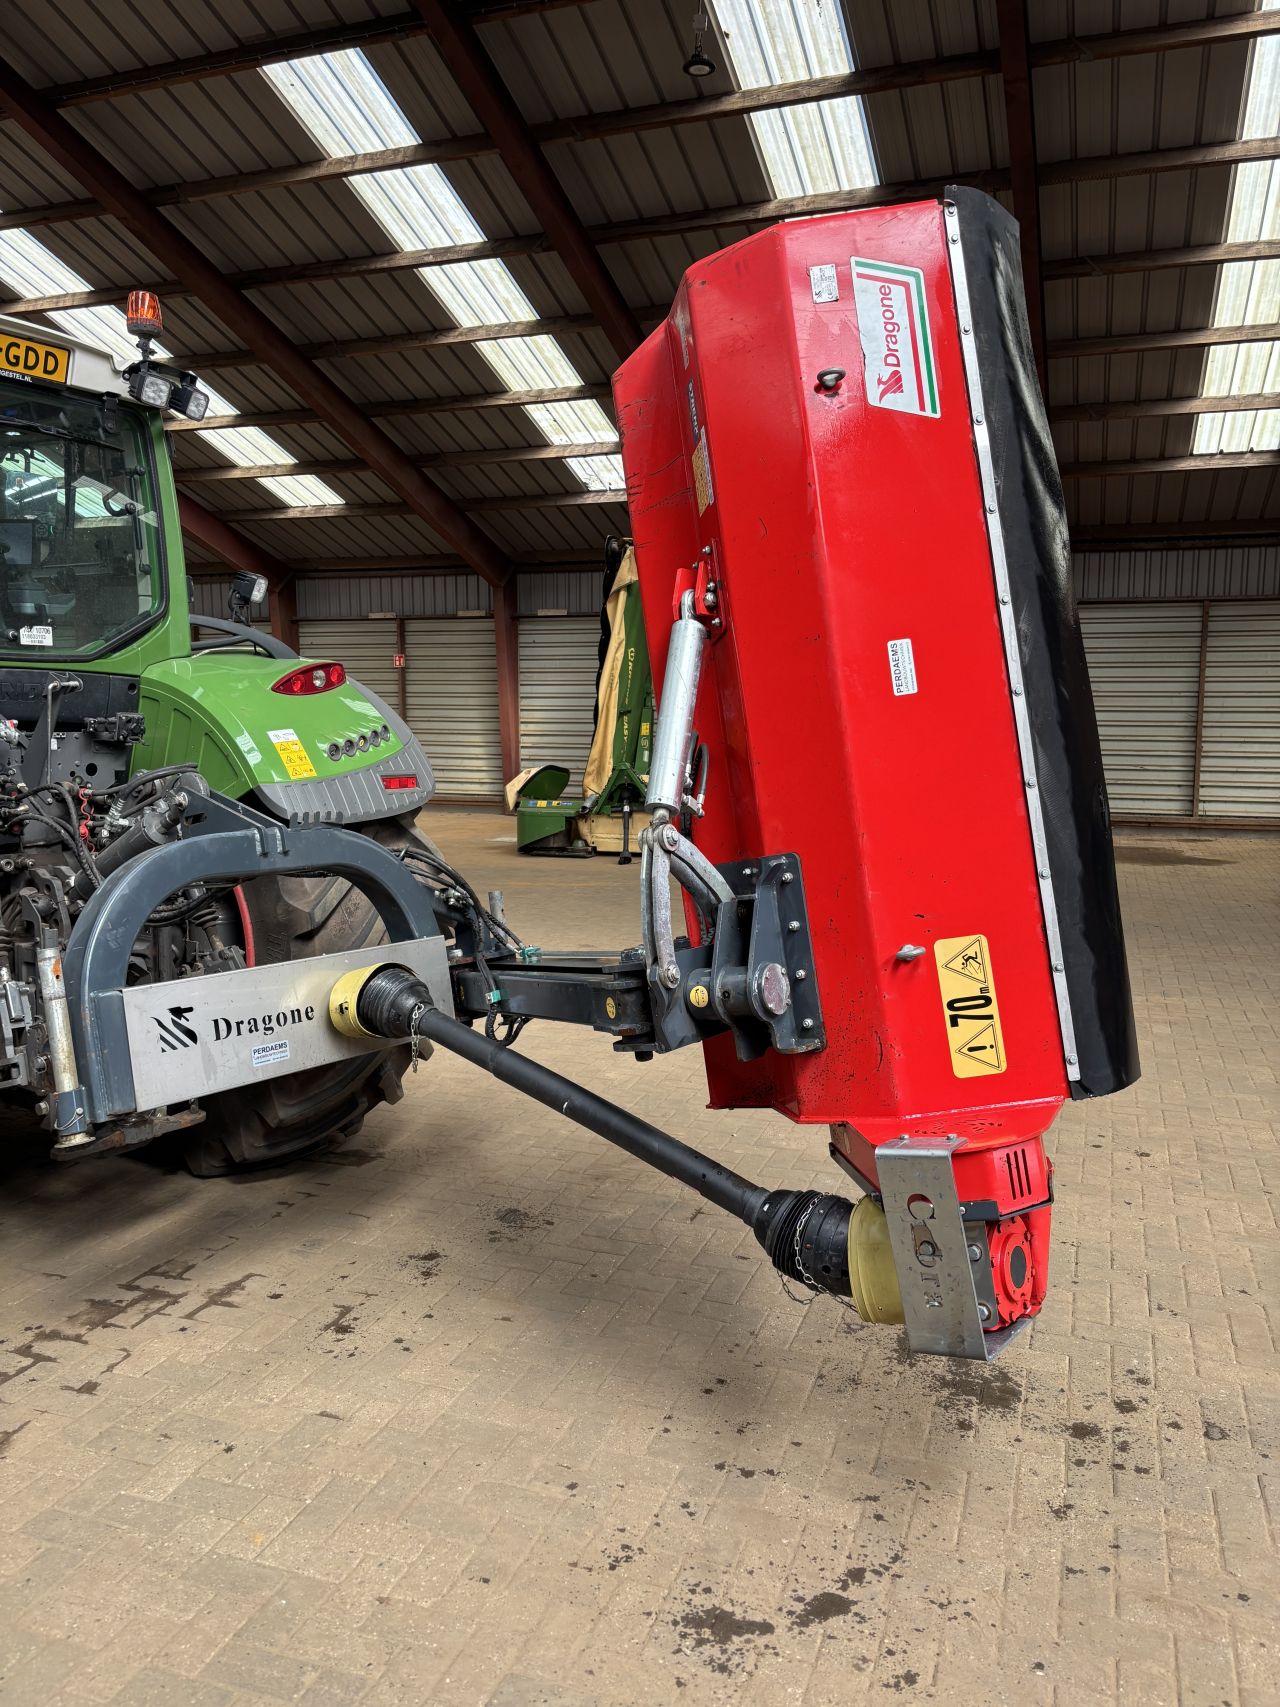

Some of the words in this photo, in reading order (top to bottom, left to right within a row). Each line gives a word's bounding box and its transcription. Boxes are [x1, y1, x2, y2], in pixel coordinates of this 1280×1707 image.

[879, 284, 901, 368] Dragone
[890, 642, 904, 694] PERDAEMS
[211, 1005, 315, 1042] Dragone
[252, 1041, 288, 1056] PERDAEMS
